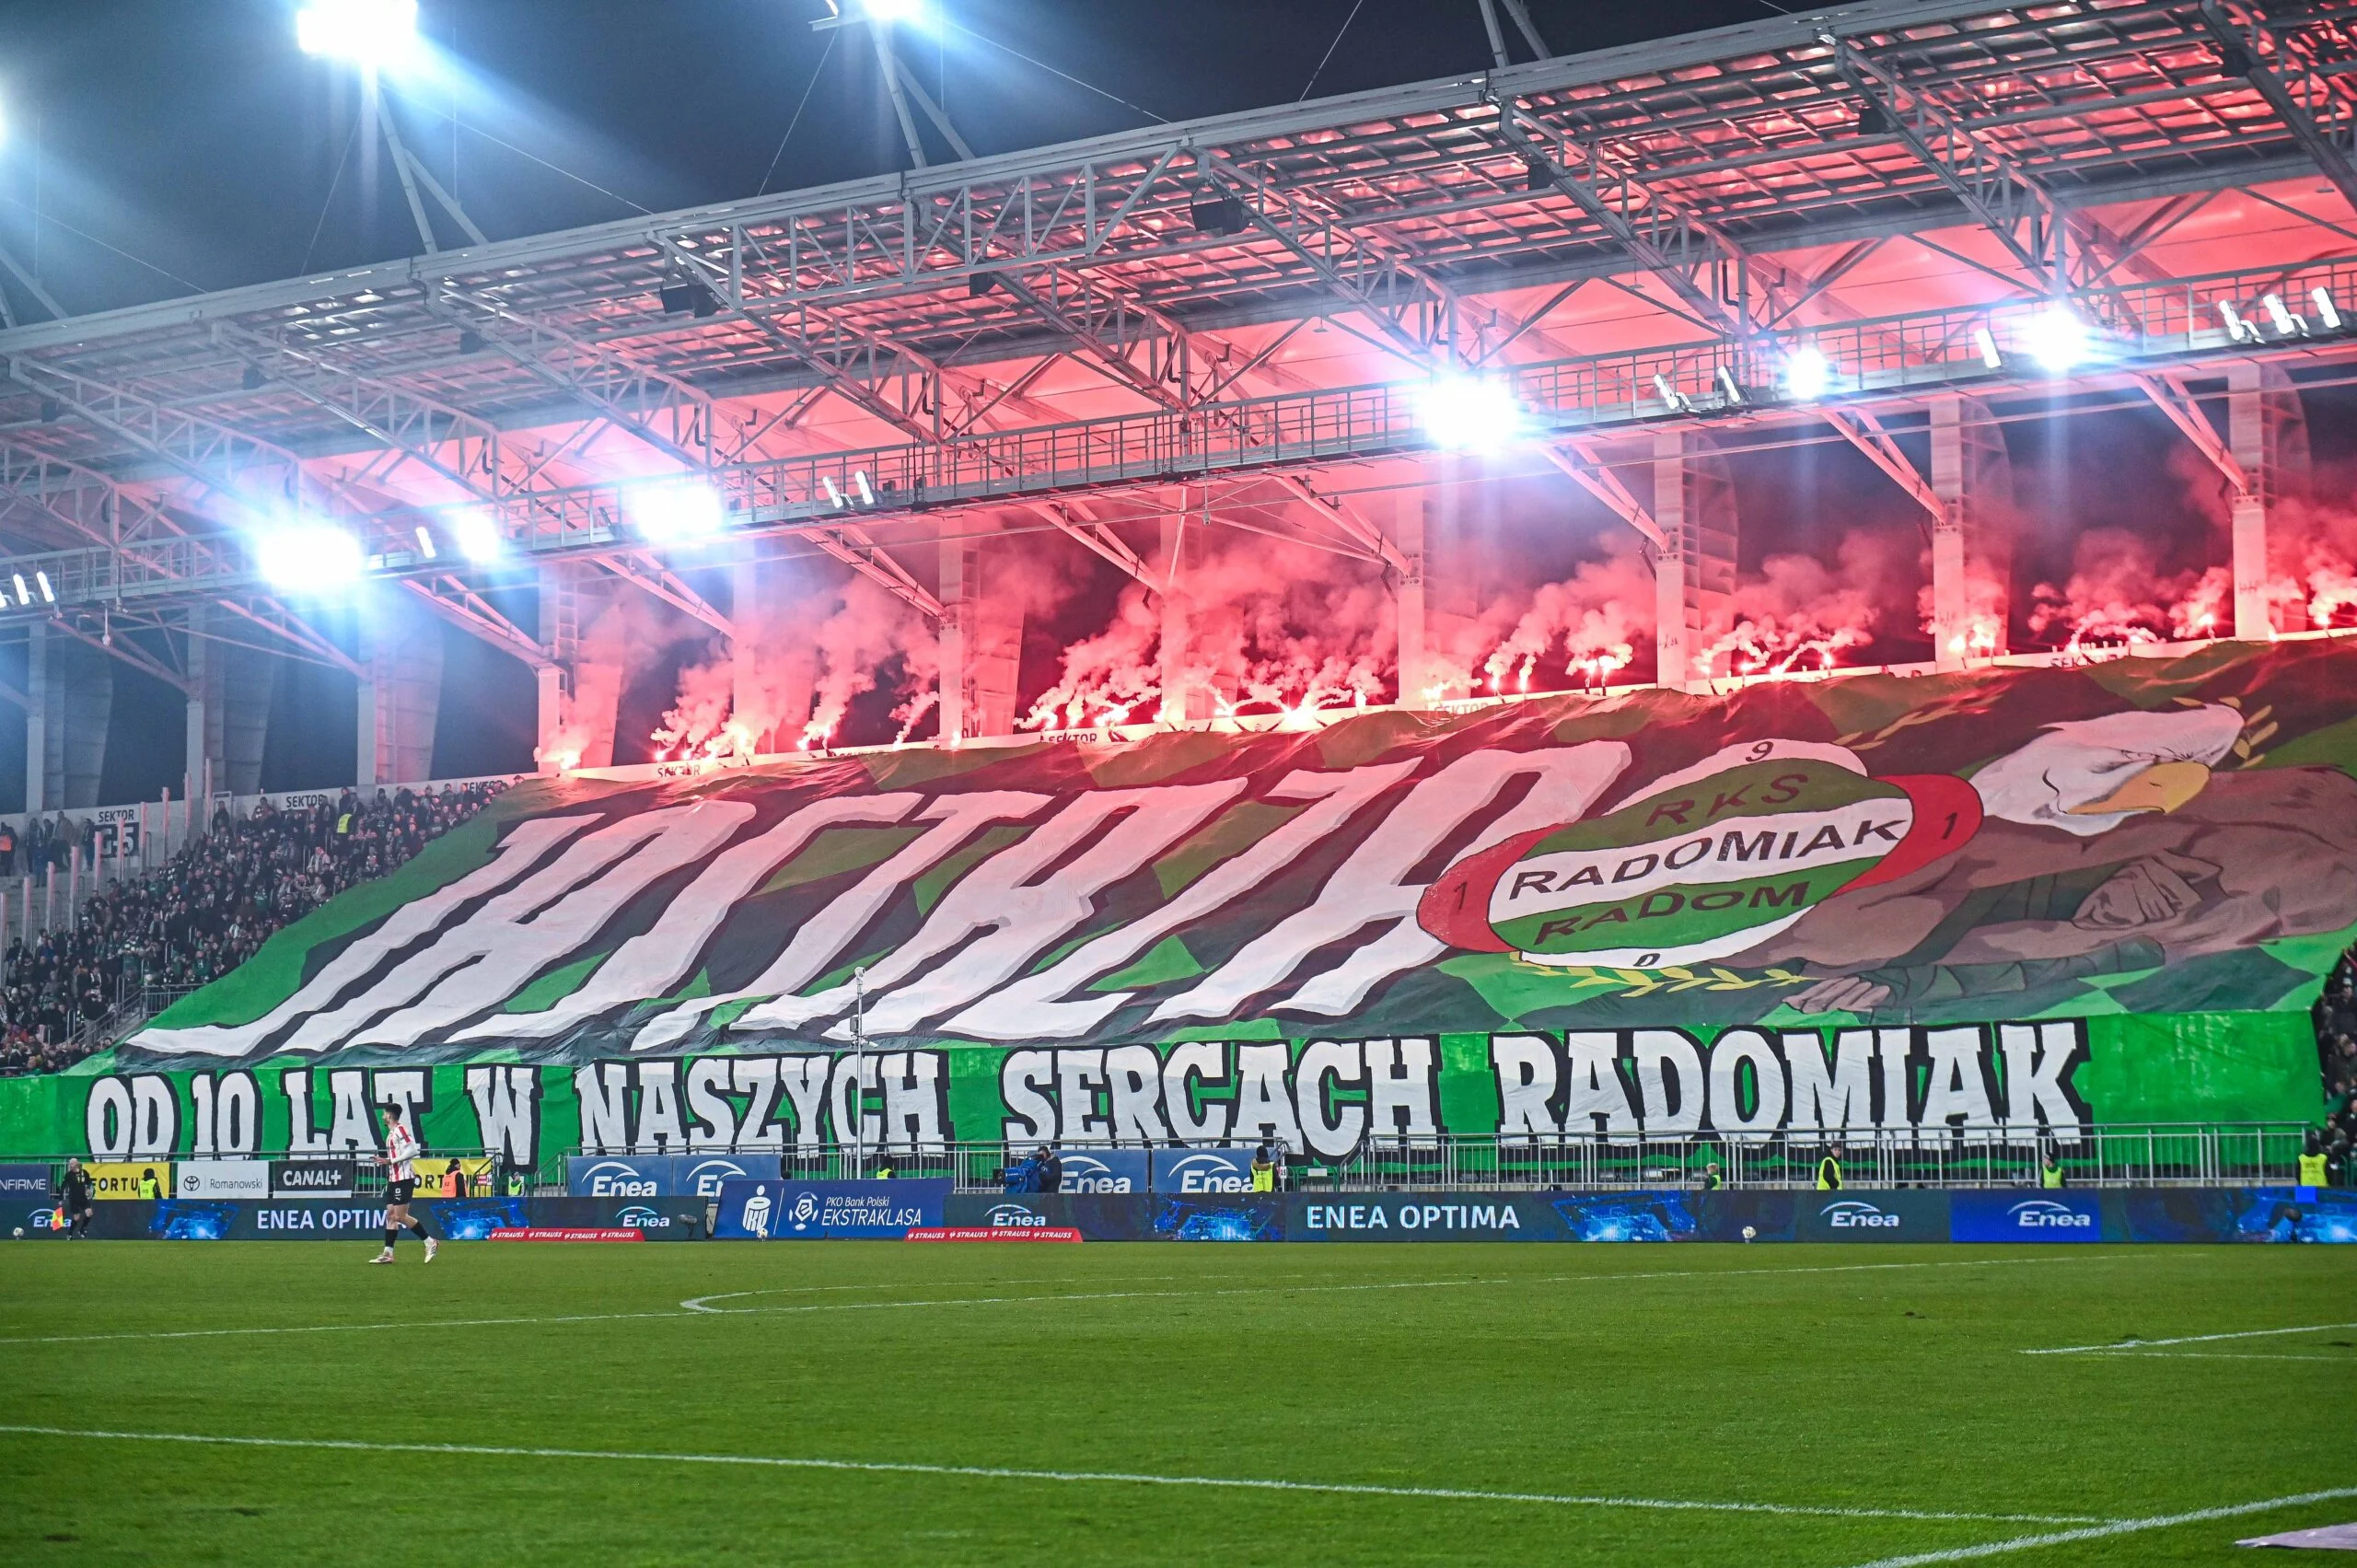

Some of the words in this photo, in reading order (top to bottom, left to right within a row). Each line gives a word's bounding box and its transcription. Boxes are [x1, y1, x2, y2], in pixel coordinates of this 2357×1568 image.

[1744, 740, 1774, 763] 9
[1644, 772, 1810, 829] RKS
[99, 808, 134, 822] SEKTOR
[1940, 812, 1958, 842] 1
[1508, 818, 1907, 901] RADOMIAK
[1452, 880, 1468, 912] 1
[1533, 880, 1811, 948] RADOM
[87, 1074, 179, 1162] OD
[191, 1069, 261, 1162] 10
[284, 1067, 430, 1165] LAT
[465, 1064, 540, 1167] W
[575, 1050, 948, 1157] NASZYCH
[1004, 1038, 1442, 1157] SERCACH
[1491, 1020, 2088, 1149] RADOMIAK
[210, 1178, 263, 1190] Romanowski
[282, 1169, 343, 1187] CANAL+
[592, 1175, 657, 1197] Enea
[1060, 1170, 1132, 1193] Enea
[1181, 1169, 1254, 1193] Enea
[825, 1197, 843, 1206] PKO
[845, 1196, 865, 1206] Bank
[866, 1196, 890, 1206] Polski
[257, 1209, 315, 1229] ENEA
[622, 1214, 670, 1227] Enea
[821, 1208, 922, 1226] EKSTRAKLASA
[993, 1213, 1046, 1226] Enea
[1306, 1205, 1388, 1229] ENEA
[1399, 1205, 1520, 1229] OPTIMA
[1830, 1211, 1899, 1227] Enea
[2018, 1210, 2091, 1227] Enea
